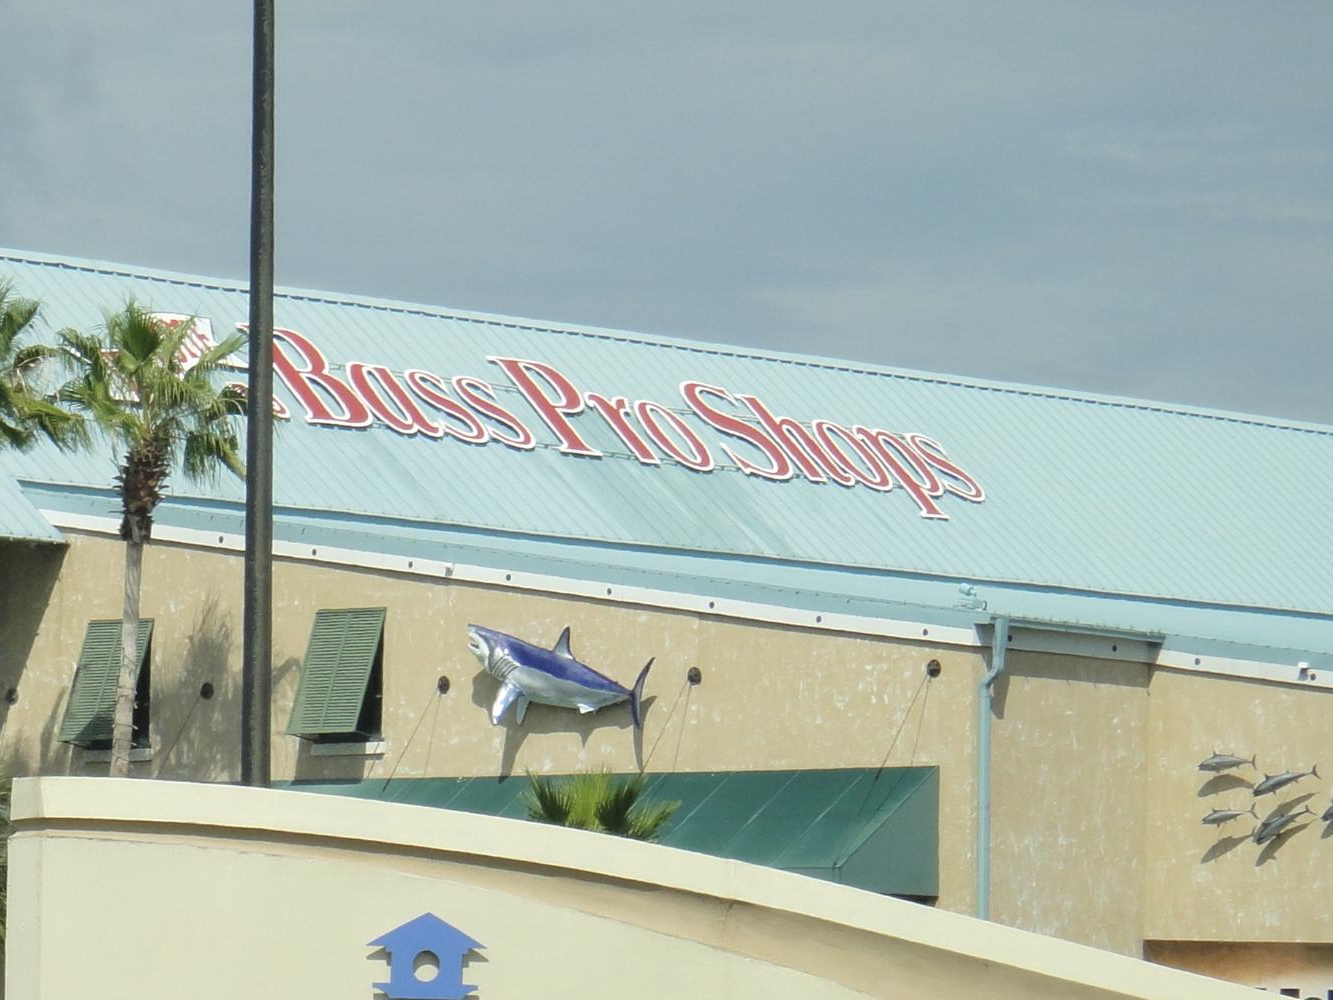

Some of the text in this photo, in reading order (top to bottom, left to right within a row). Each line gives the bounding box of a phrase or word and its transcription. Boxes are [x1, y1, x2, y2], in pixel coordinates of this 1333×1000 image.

[222, 322, 986, 520] Bass Pro Shops
